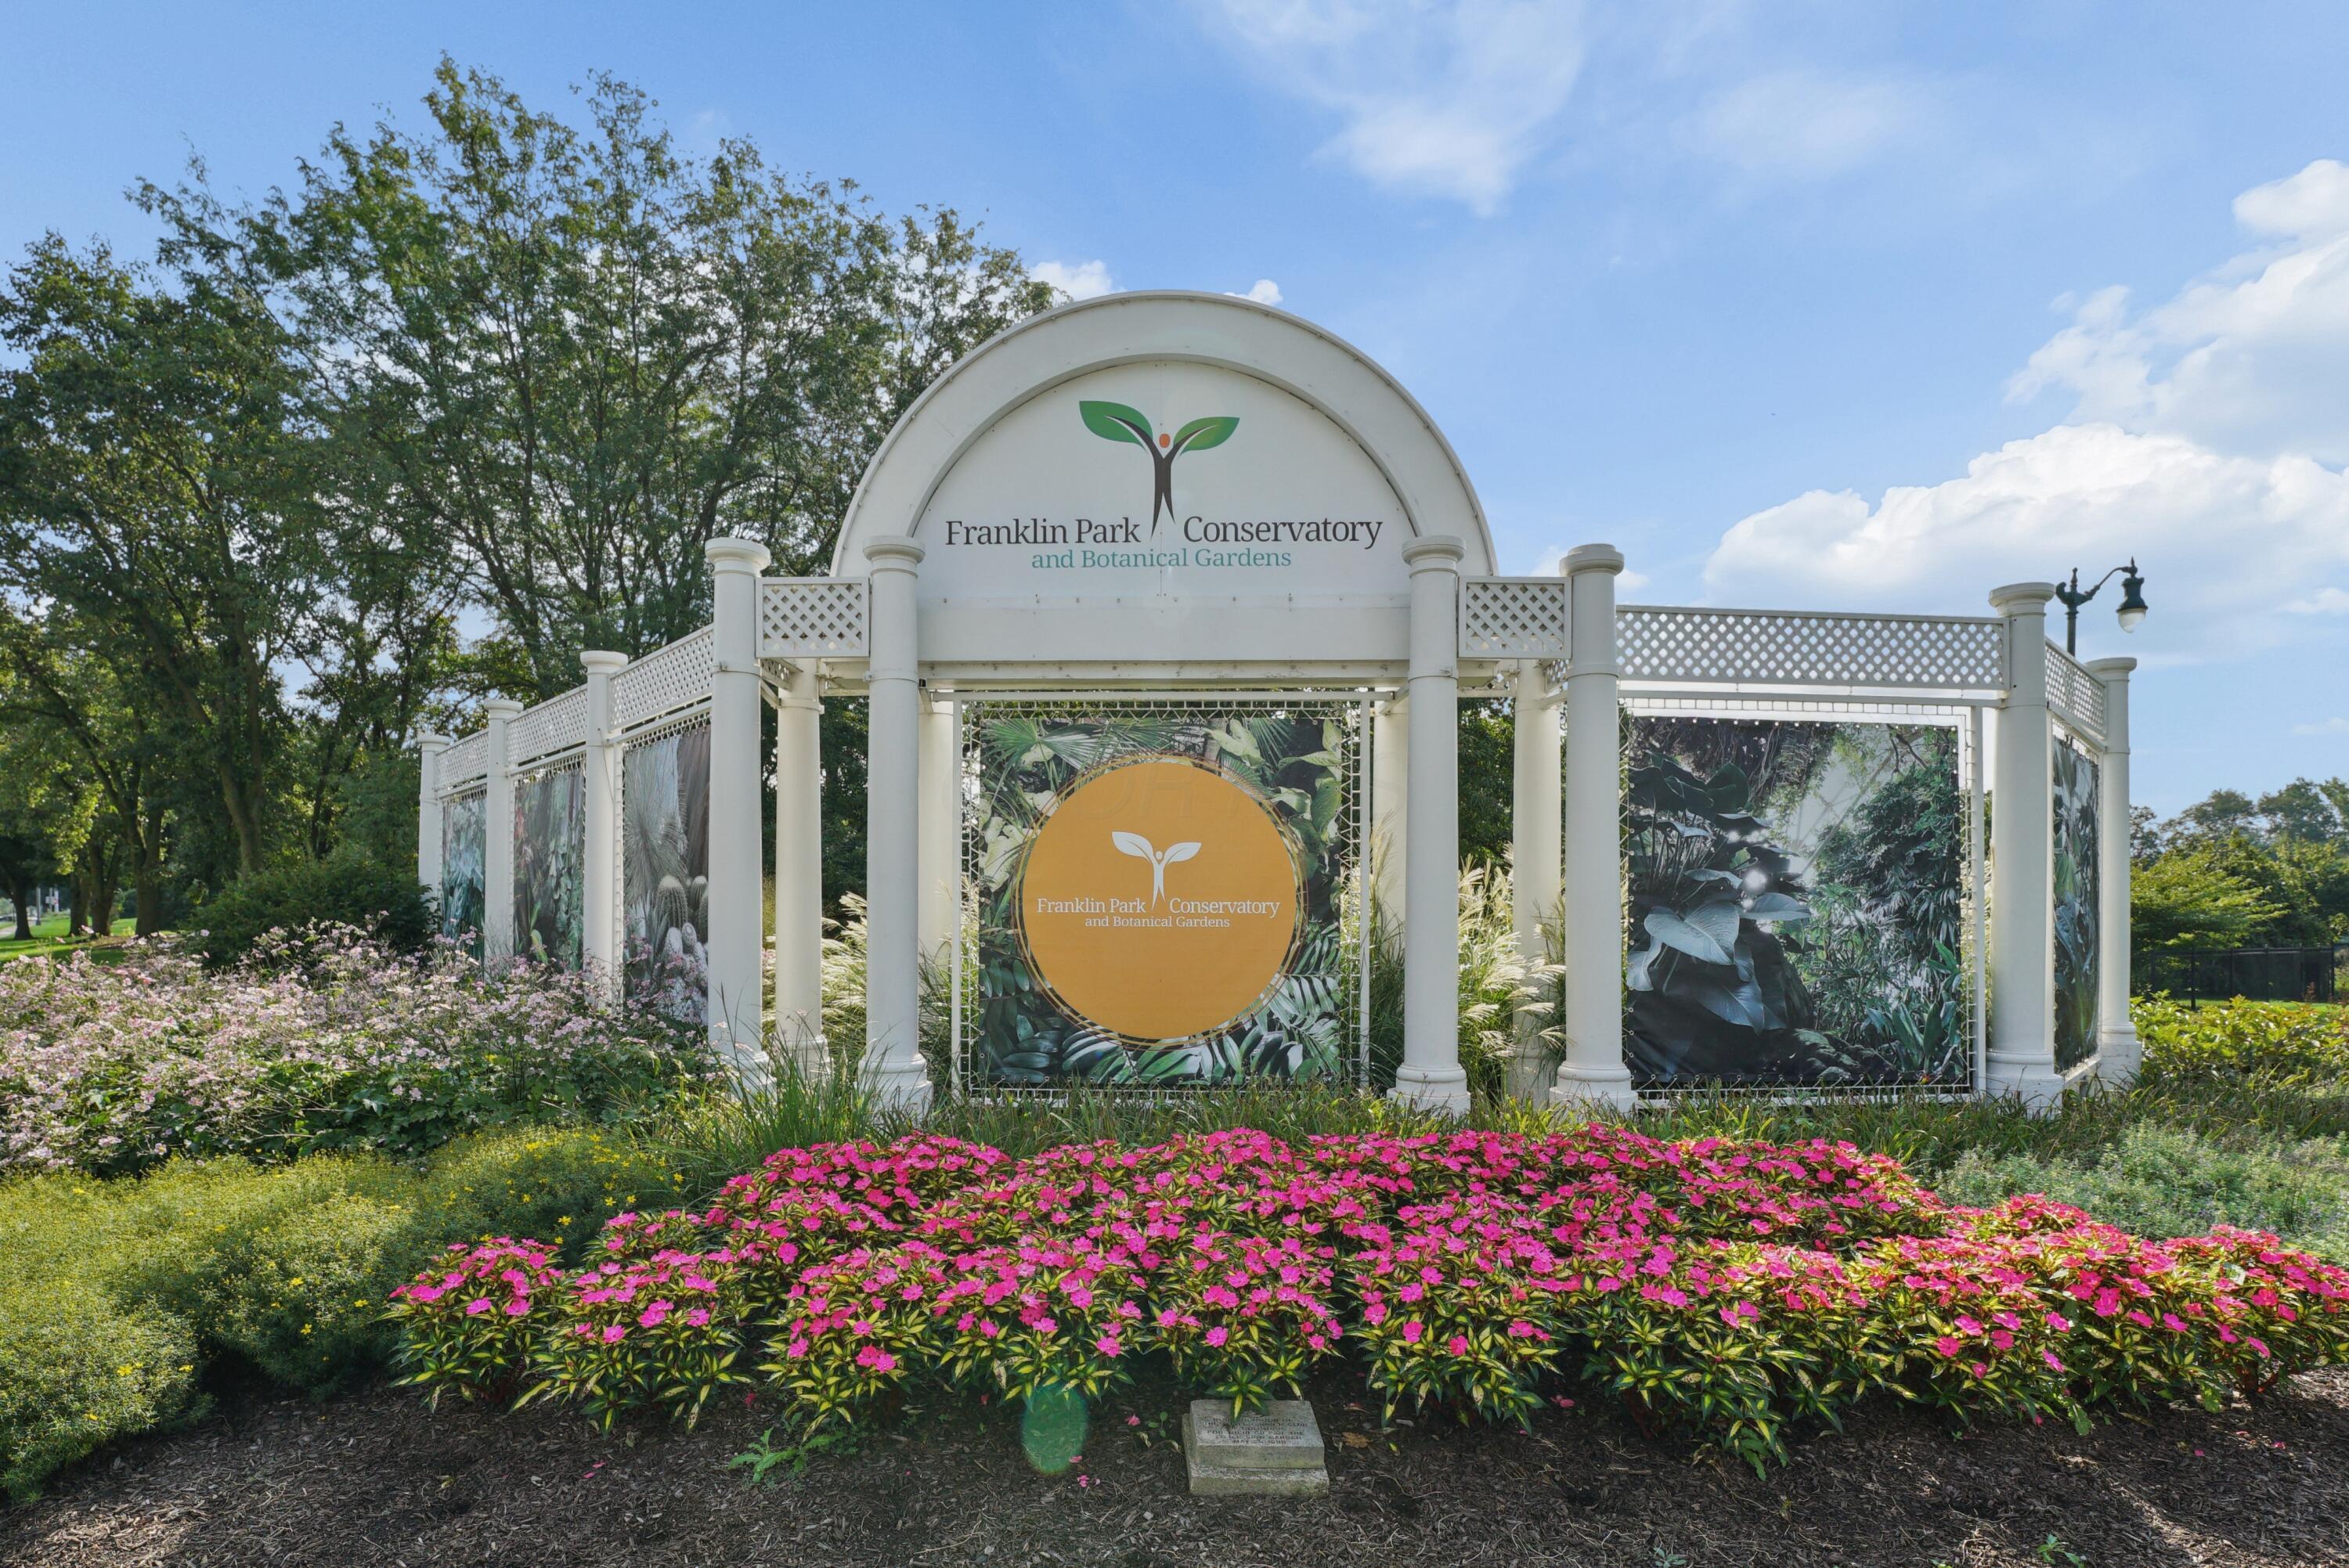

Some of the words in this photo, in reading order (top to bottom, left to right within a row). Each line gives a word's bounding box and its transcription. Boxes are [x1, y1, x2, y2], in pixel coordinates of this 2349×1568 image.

[944, 517, 1069, 546] Franklin
[1074, 517, 1142, 544] Park
[1182, 516, 1384, 550] Conservatory
[1030, 550, 1074, 569] and
[1081, 549, 1189, 569] Botanical
[1195, 548, 1292, 568] Gardens
[1036, 897, 1106, 914] Franklin
[1109, 897, 1147, 914] Park
[1169, 898, 1281, 919] Conservatory
[1084, 916, 1110, 928] and
[1113, 915, 1173, 928] Botanical
[1176, 916, 1231, 928] Gardens
